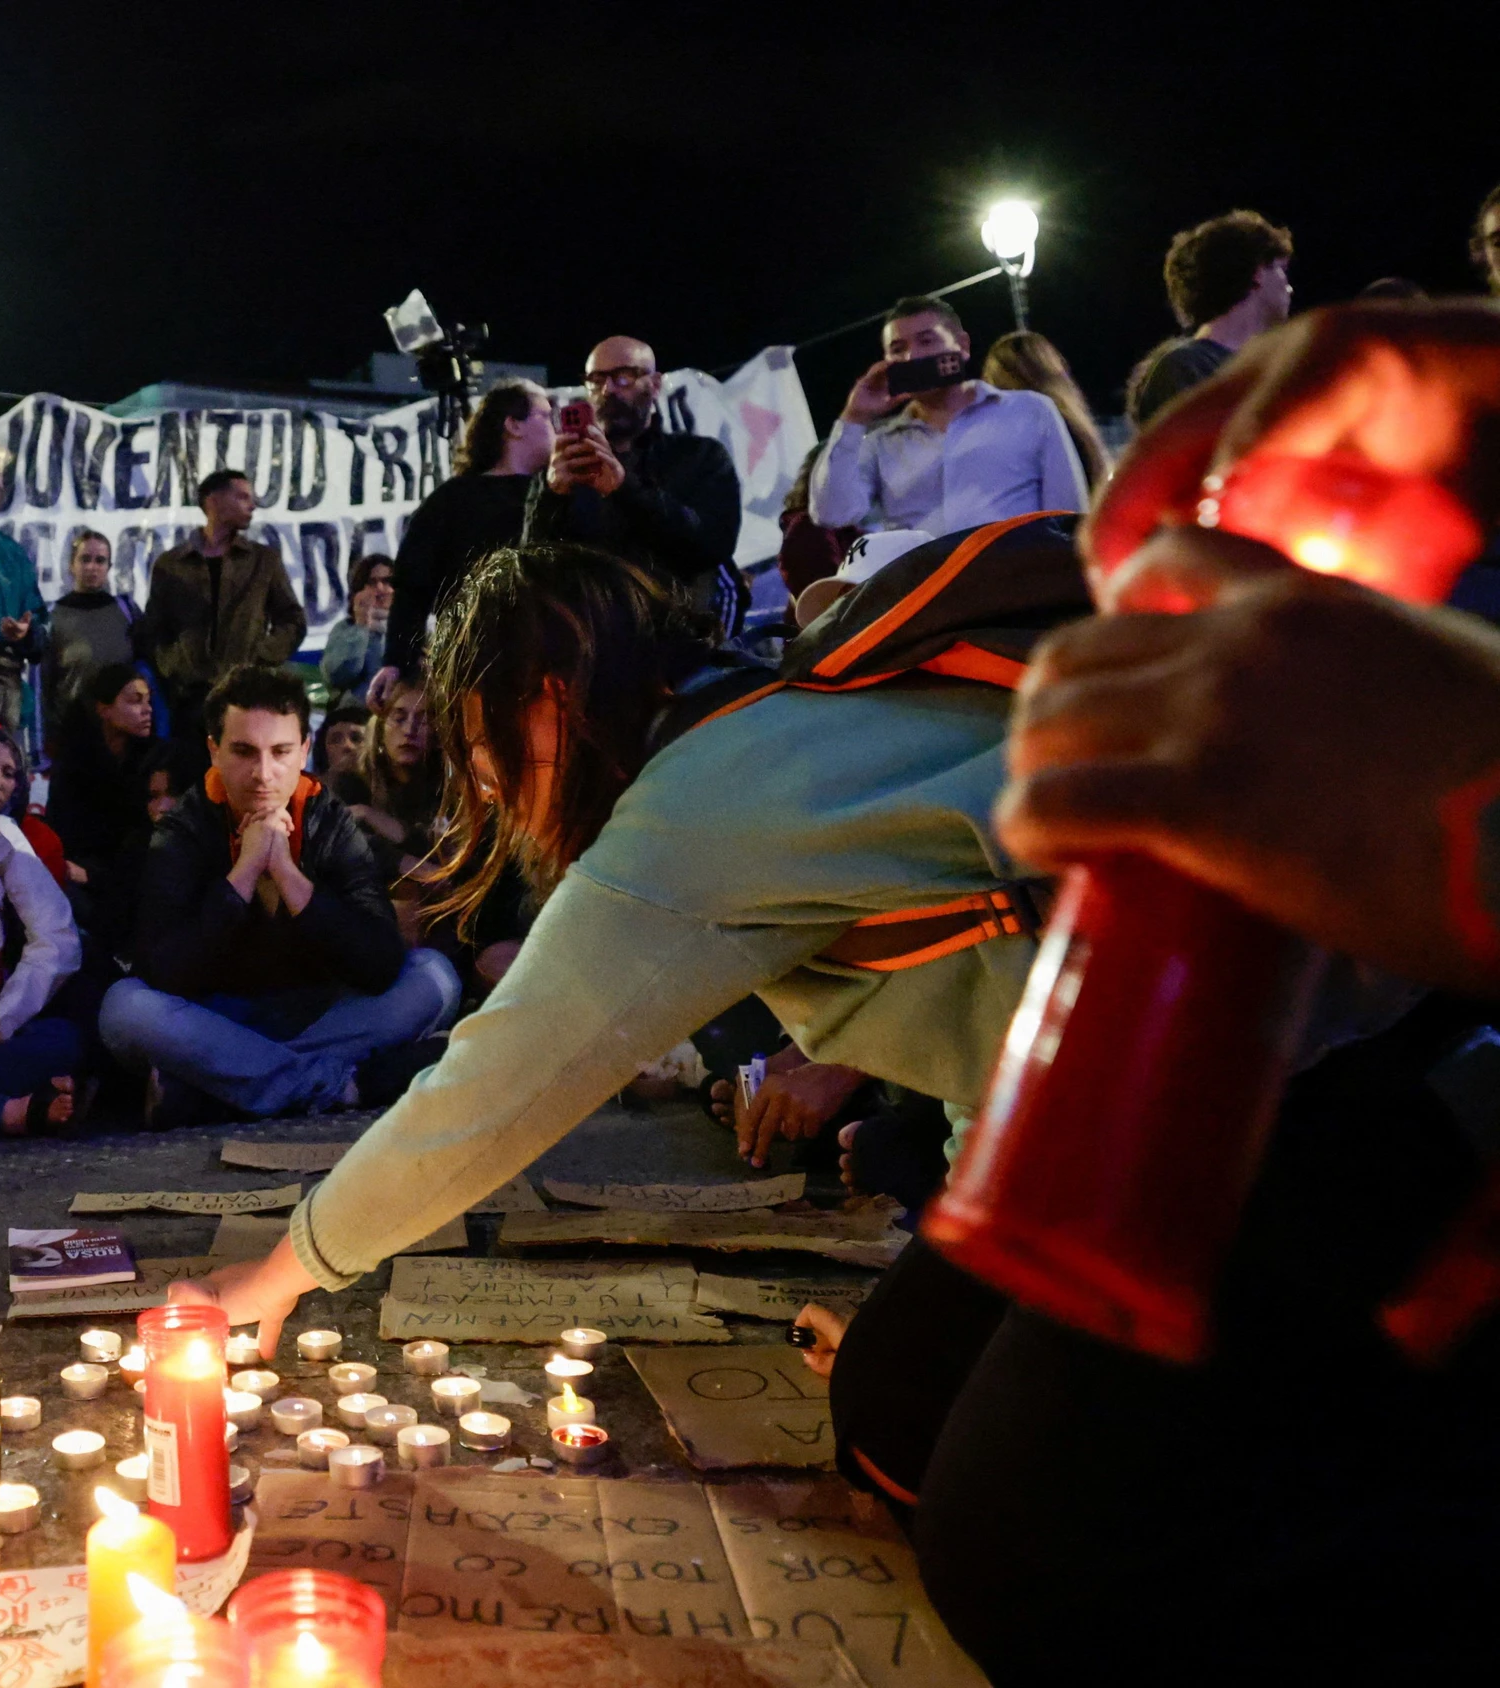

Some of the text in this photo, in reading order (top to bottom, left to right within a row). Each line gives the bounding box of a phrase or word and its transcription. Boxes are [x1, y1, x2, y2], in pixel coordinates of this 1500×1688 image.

[64, 1246, 122, 1260] ROSA
[567, 1559, 719, 1586] TODO
[768, 1552, 896, 1587] POR
[396, 1588, 911, 1669] LUCHAREMO
